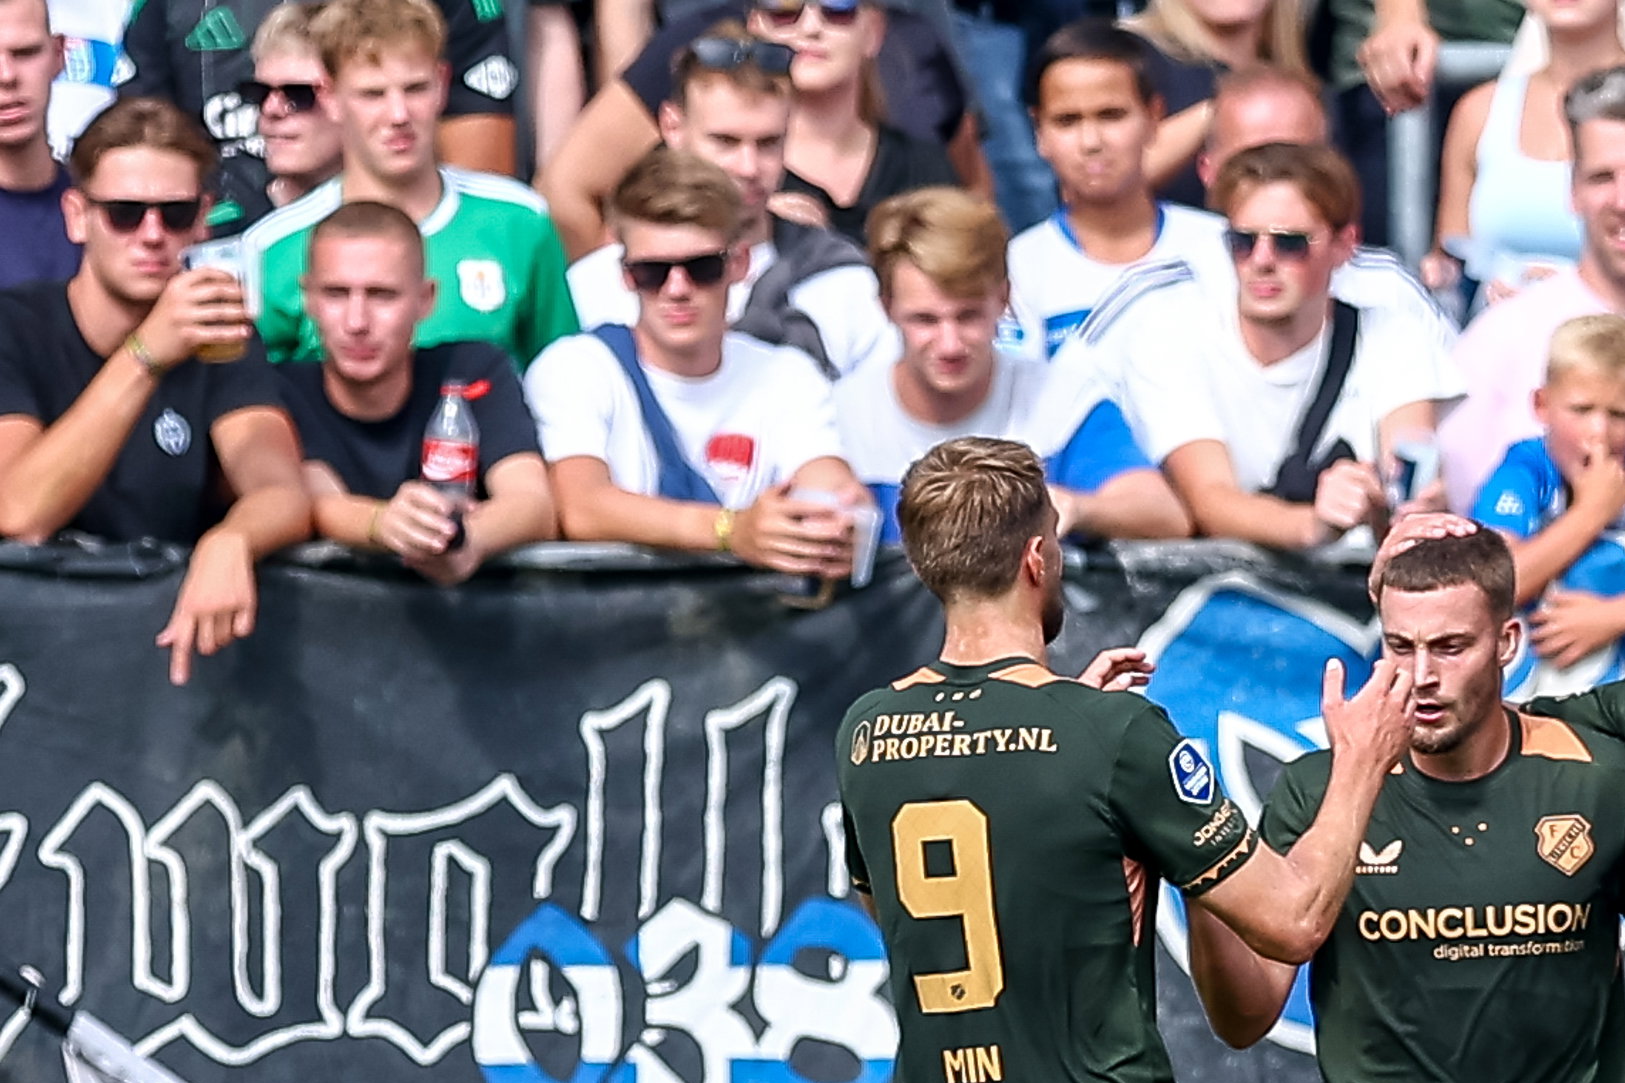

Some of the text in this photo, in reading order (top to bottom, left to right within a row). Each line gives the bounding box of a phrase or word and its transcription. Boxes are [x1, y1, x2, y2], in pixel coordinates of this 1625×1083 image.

[873, 710, 965, 737] DUBAI-
[871, 727, 1058, 763] PROPERTY.NL
[892, 799, 1004, 1015] 9
[1358, 902, 1592, 941] CONCLUSION
[1433, 942, 1484, 962] digital
